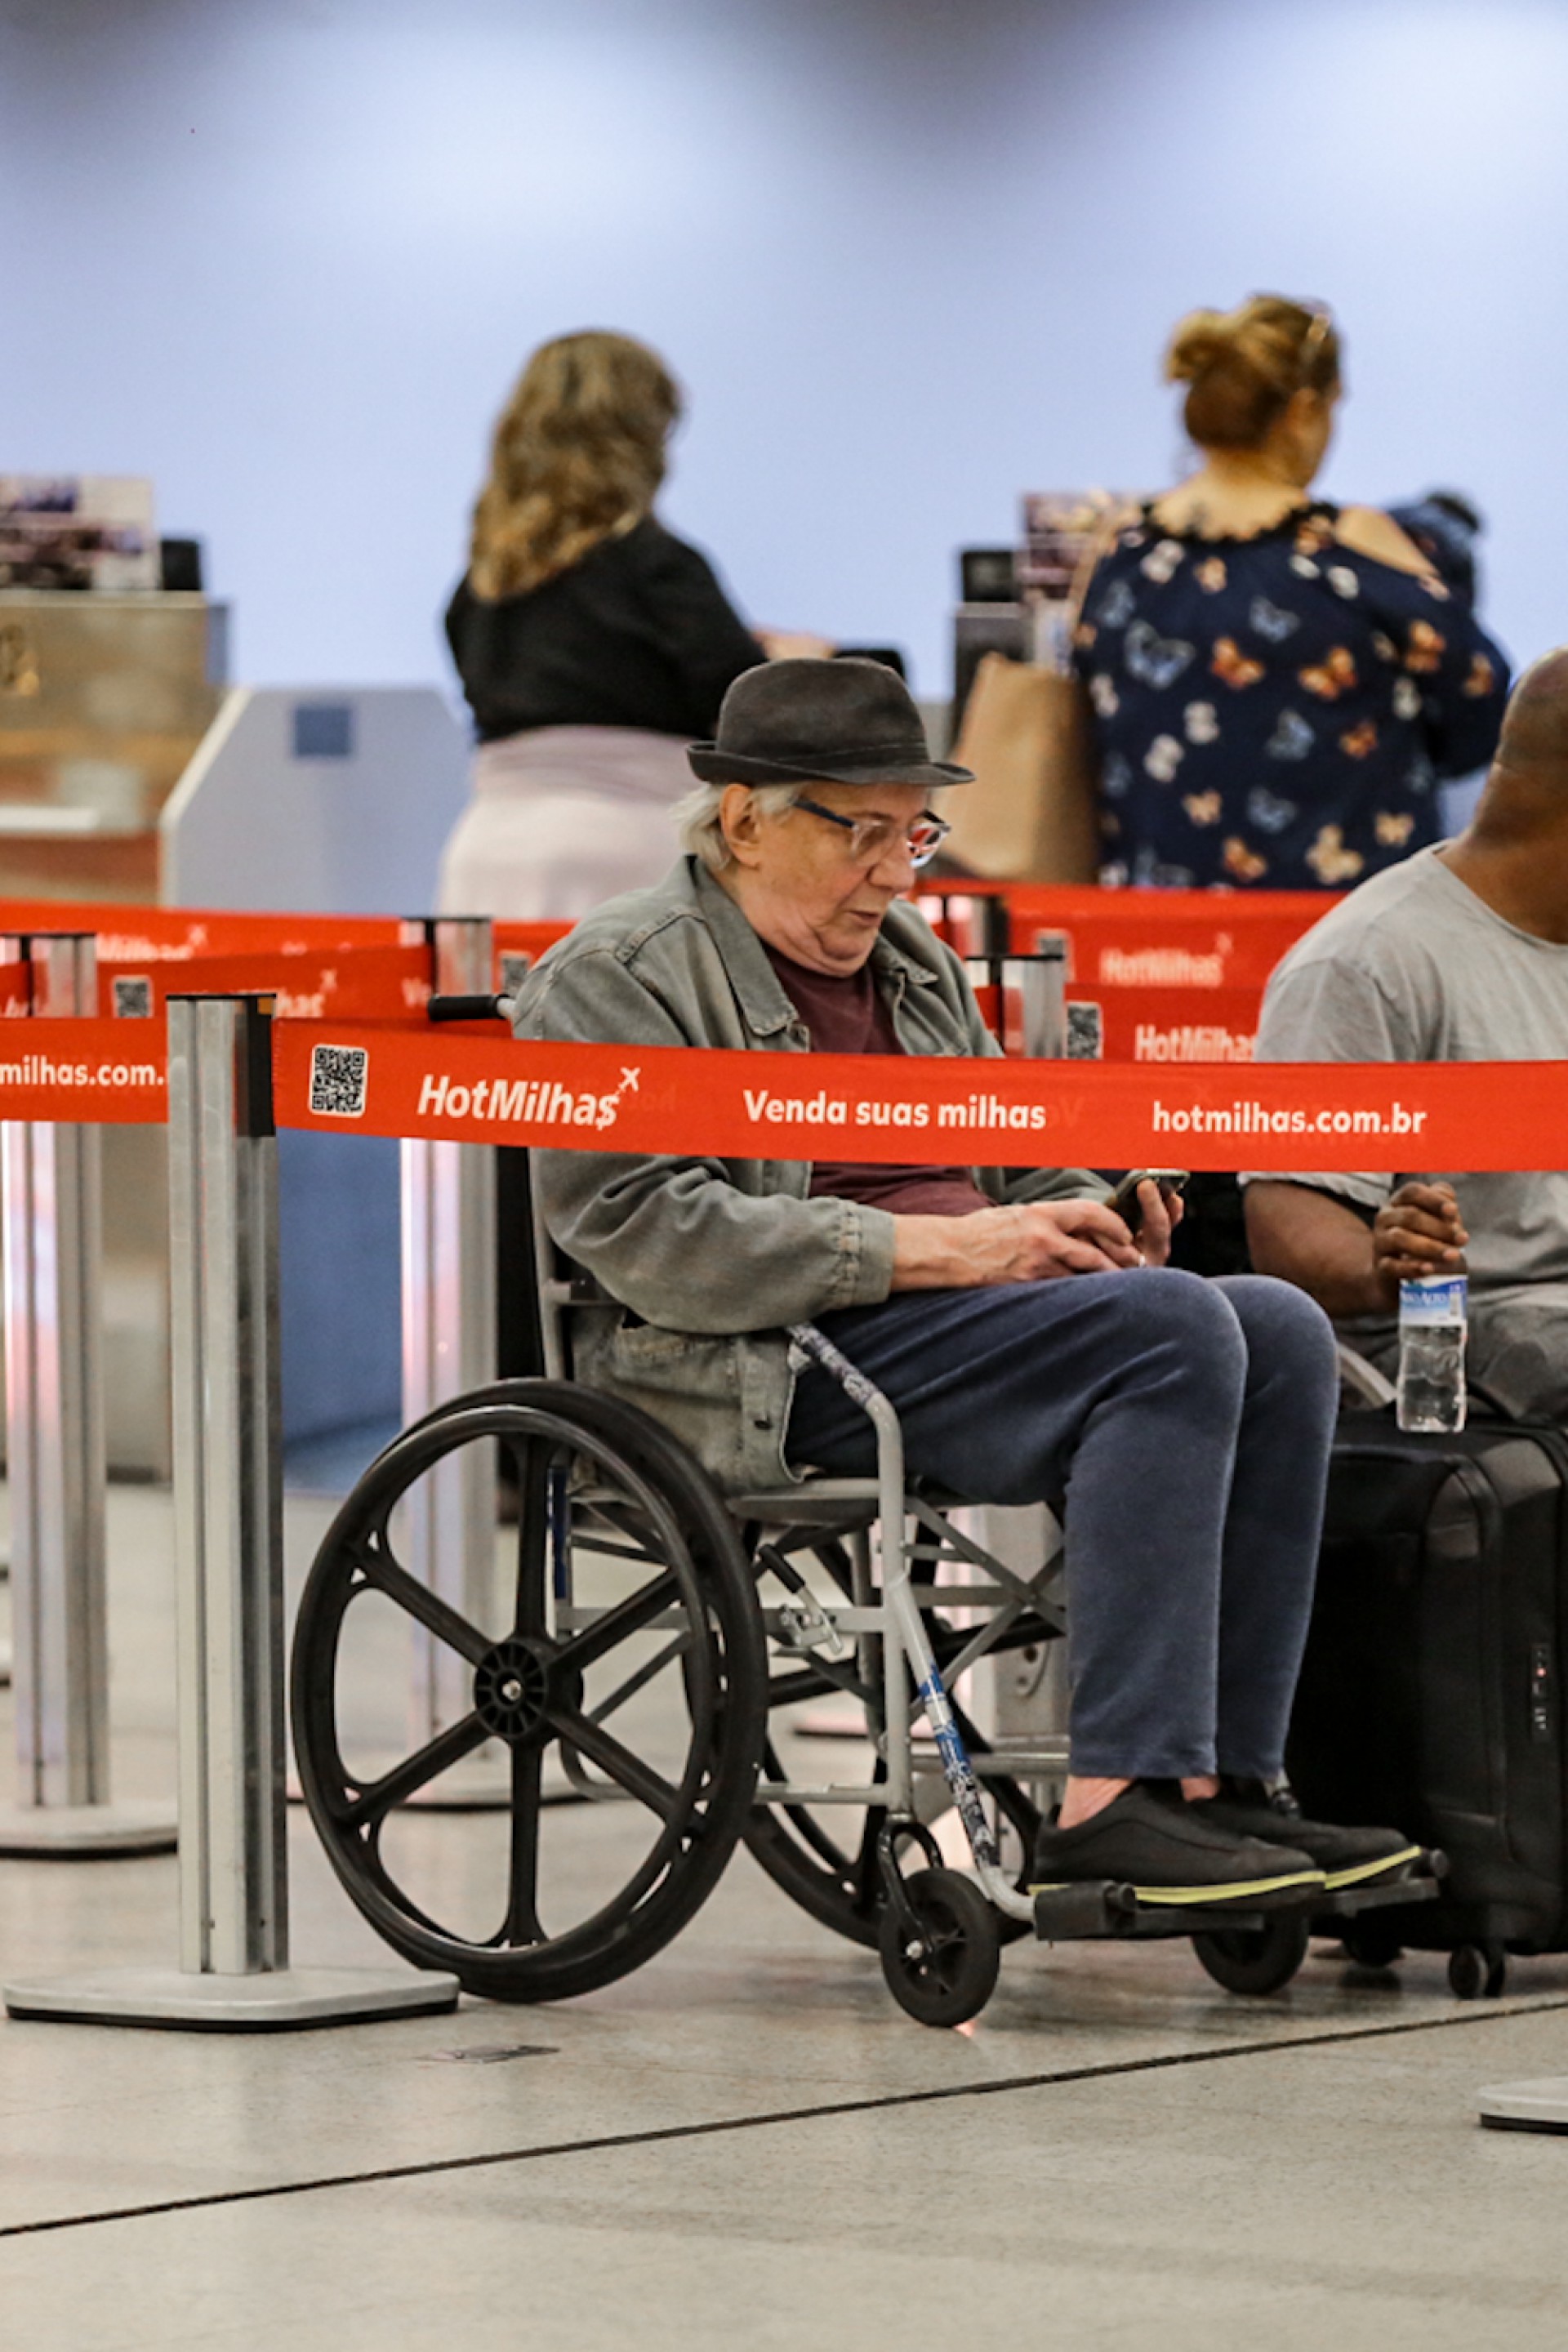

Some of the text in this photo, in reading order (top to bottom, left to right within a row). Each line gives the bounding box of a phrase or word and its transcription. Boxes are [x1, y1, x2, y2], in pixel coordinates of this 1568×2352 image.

[742, 1089, 1046, 1129] Venda suas milhas
[1152, 1100, 1427, 1134] hotmilhas.com.br
